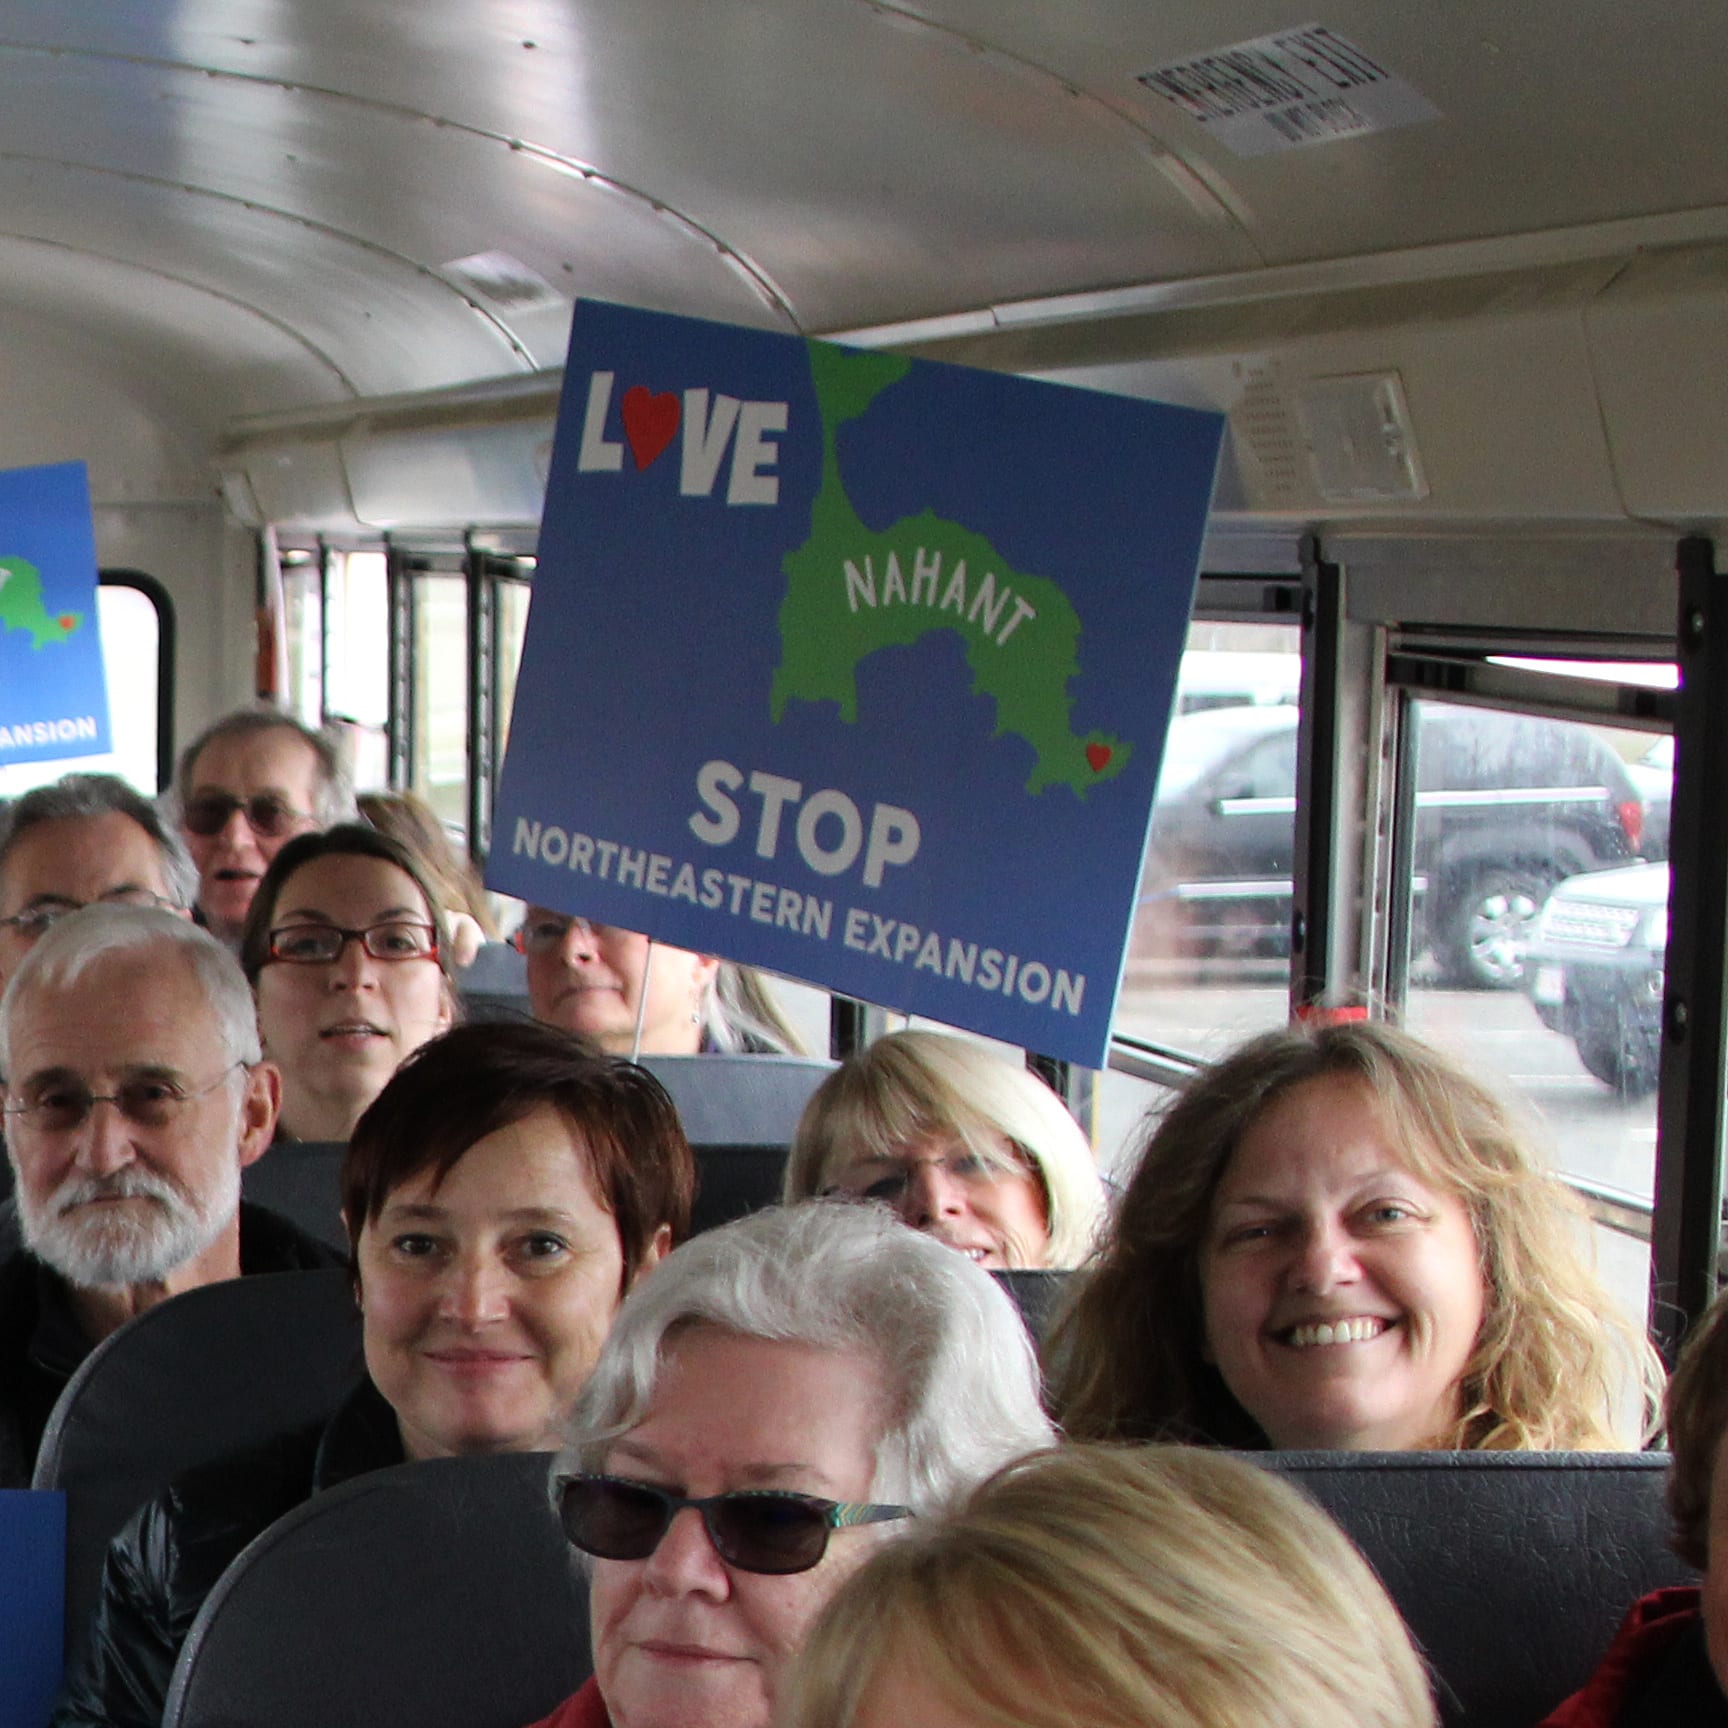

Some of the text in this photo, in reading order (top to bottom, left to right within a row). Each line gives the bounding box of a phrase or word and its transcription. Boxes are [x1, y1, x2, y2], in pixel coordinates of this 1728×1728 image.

[843, 546, 1036, 646] NAHANT
[688, 760, 921, 888] STOP
[512, 817, 1086, 1016] NORTHEASTERN EXPANSION
